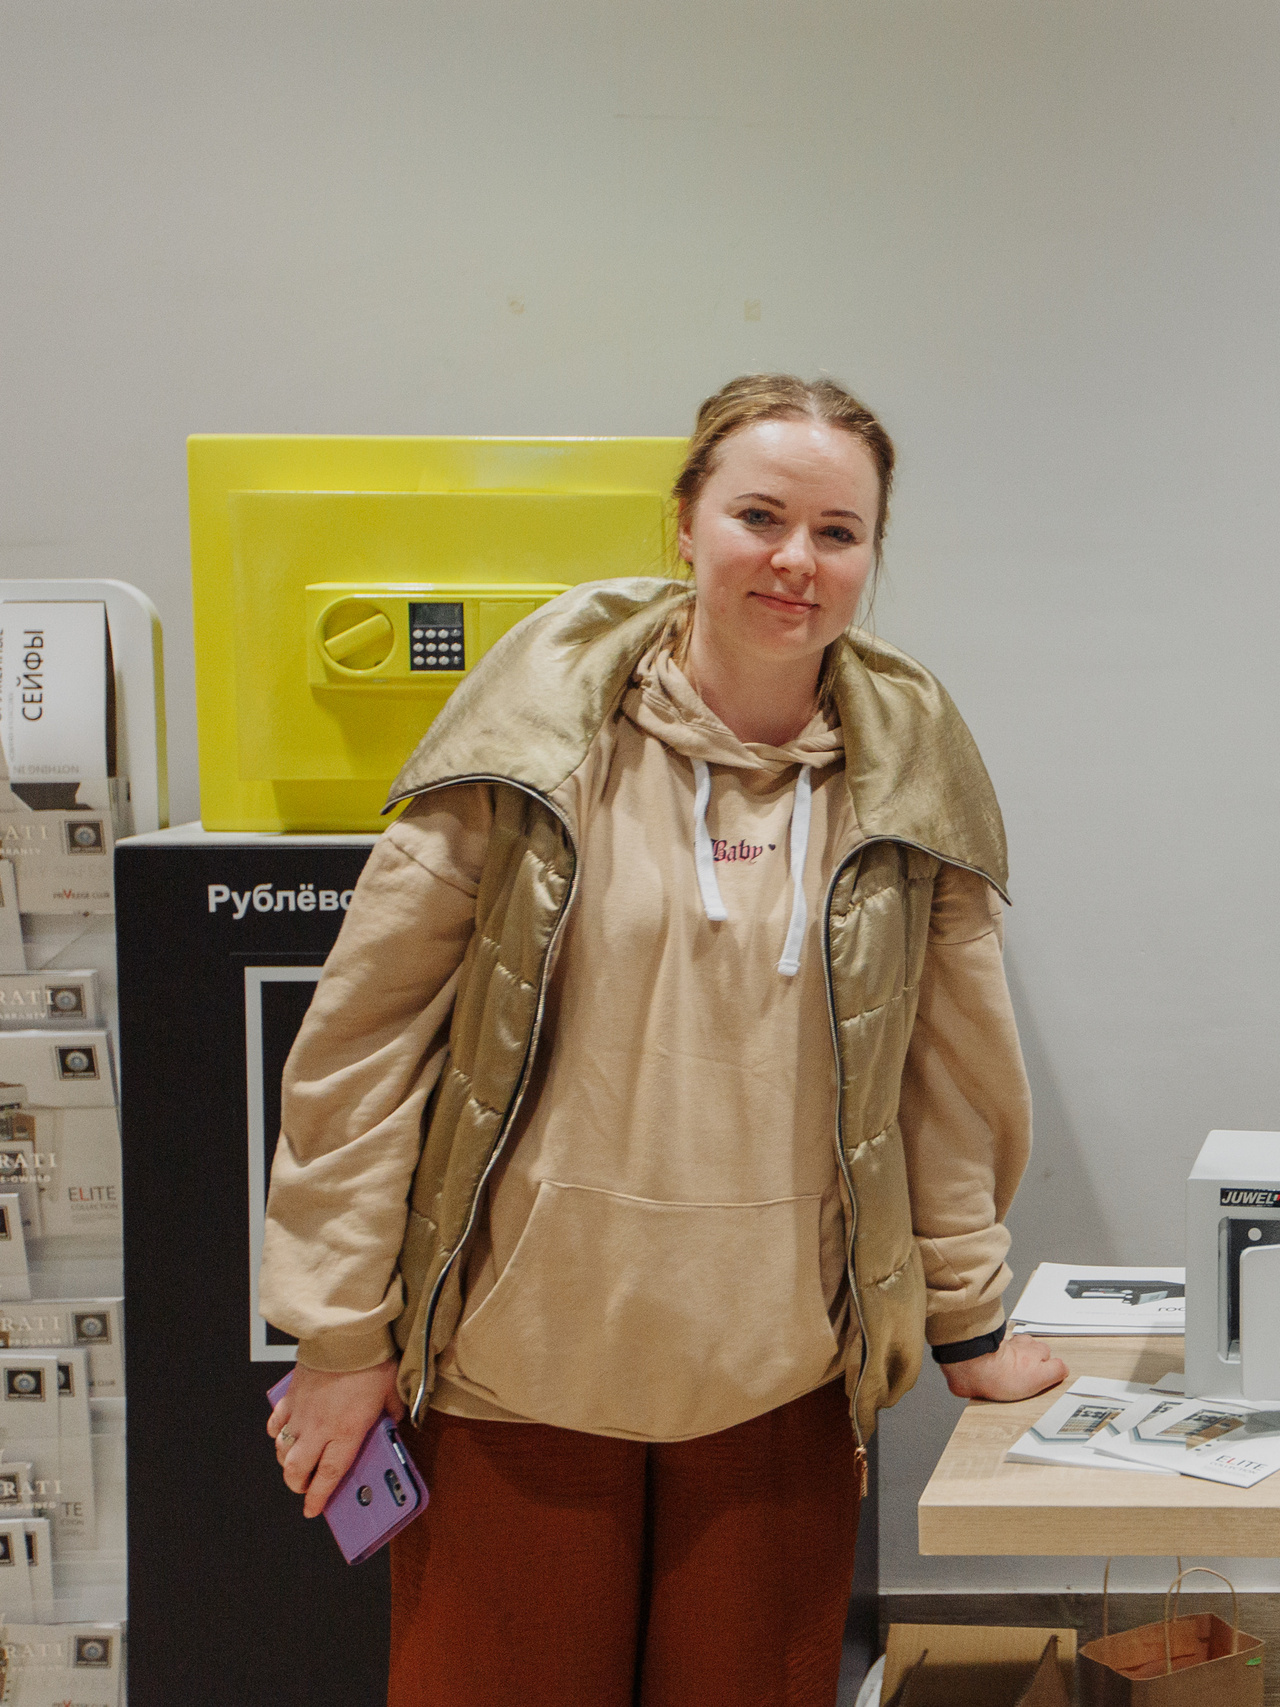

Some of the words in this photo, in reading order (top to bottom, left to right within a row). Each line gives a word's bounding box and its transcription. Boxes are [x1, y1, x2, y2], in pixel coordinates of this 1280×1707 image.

[16, 629, 44, 722] СЕЙФЫ
[710, 838, 763, 865] Baby
[68, 1186, 117, 1202] ELITE
[1221, 1191, 1275, 1204] JUWEL
[1216, 1455, 1268, 1470] ELITE
